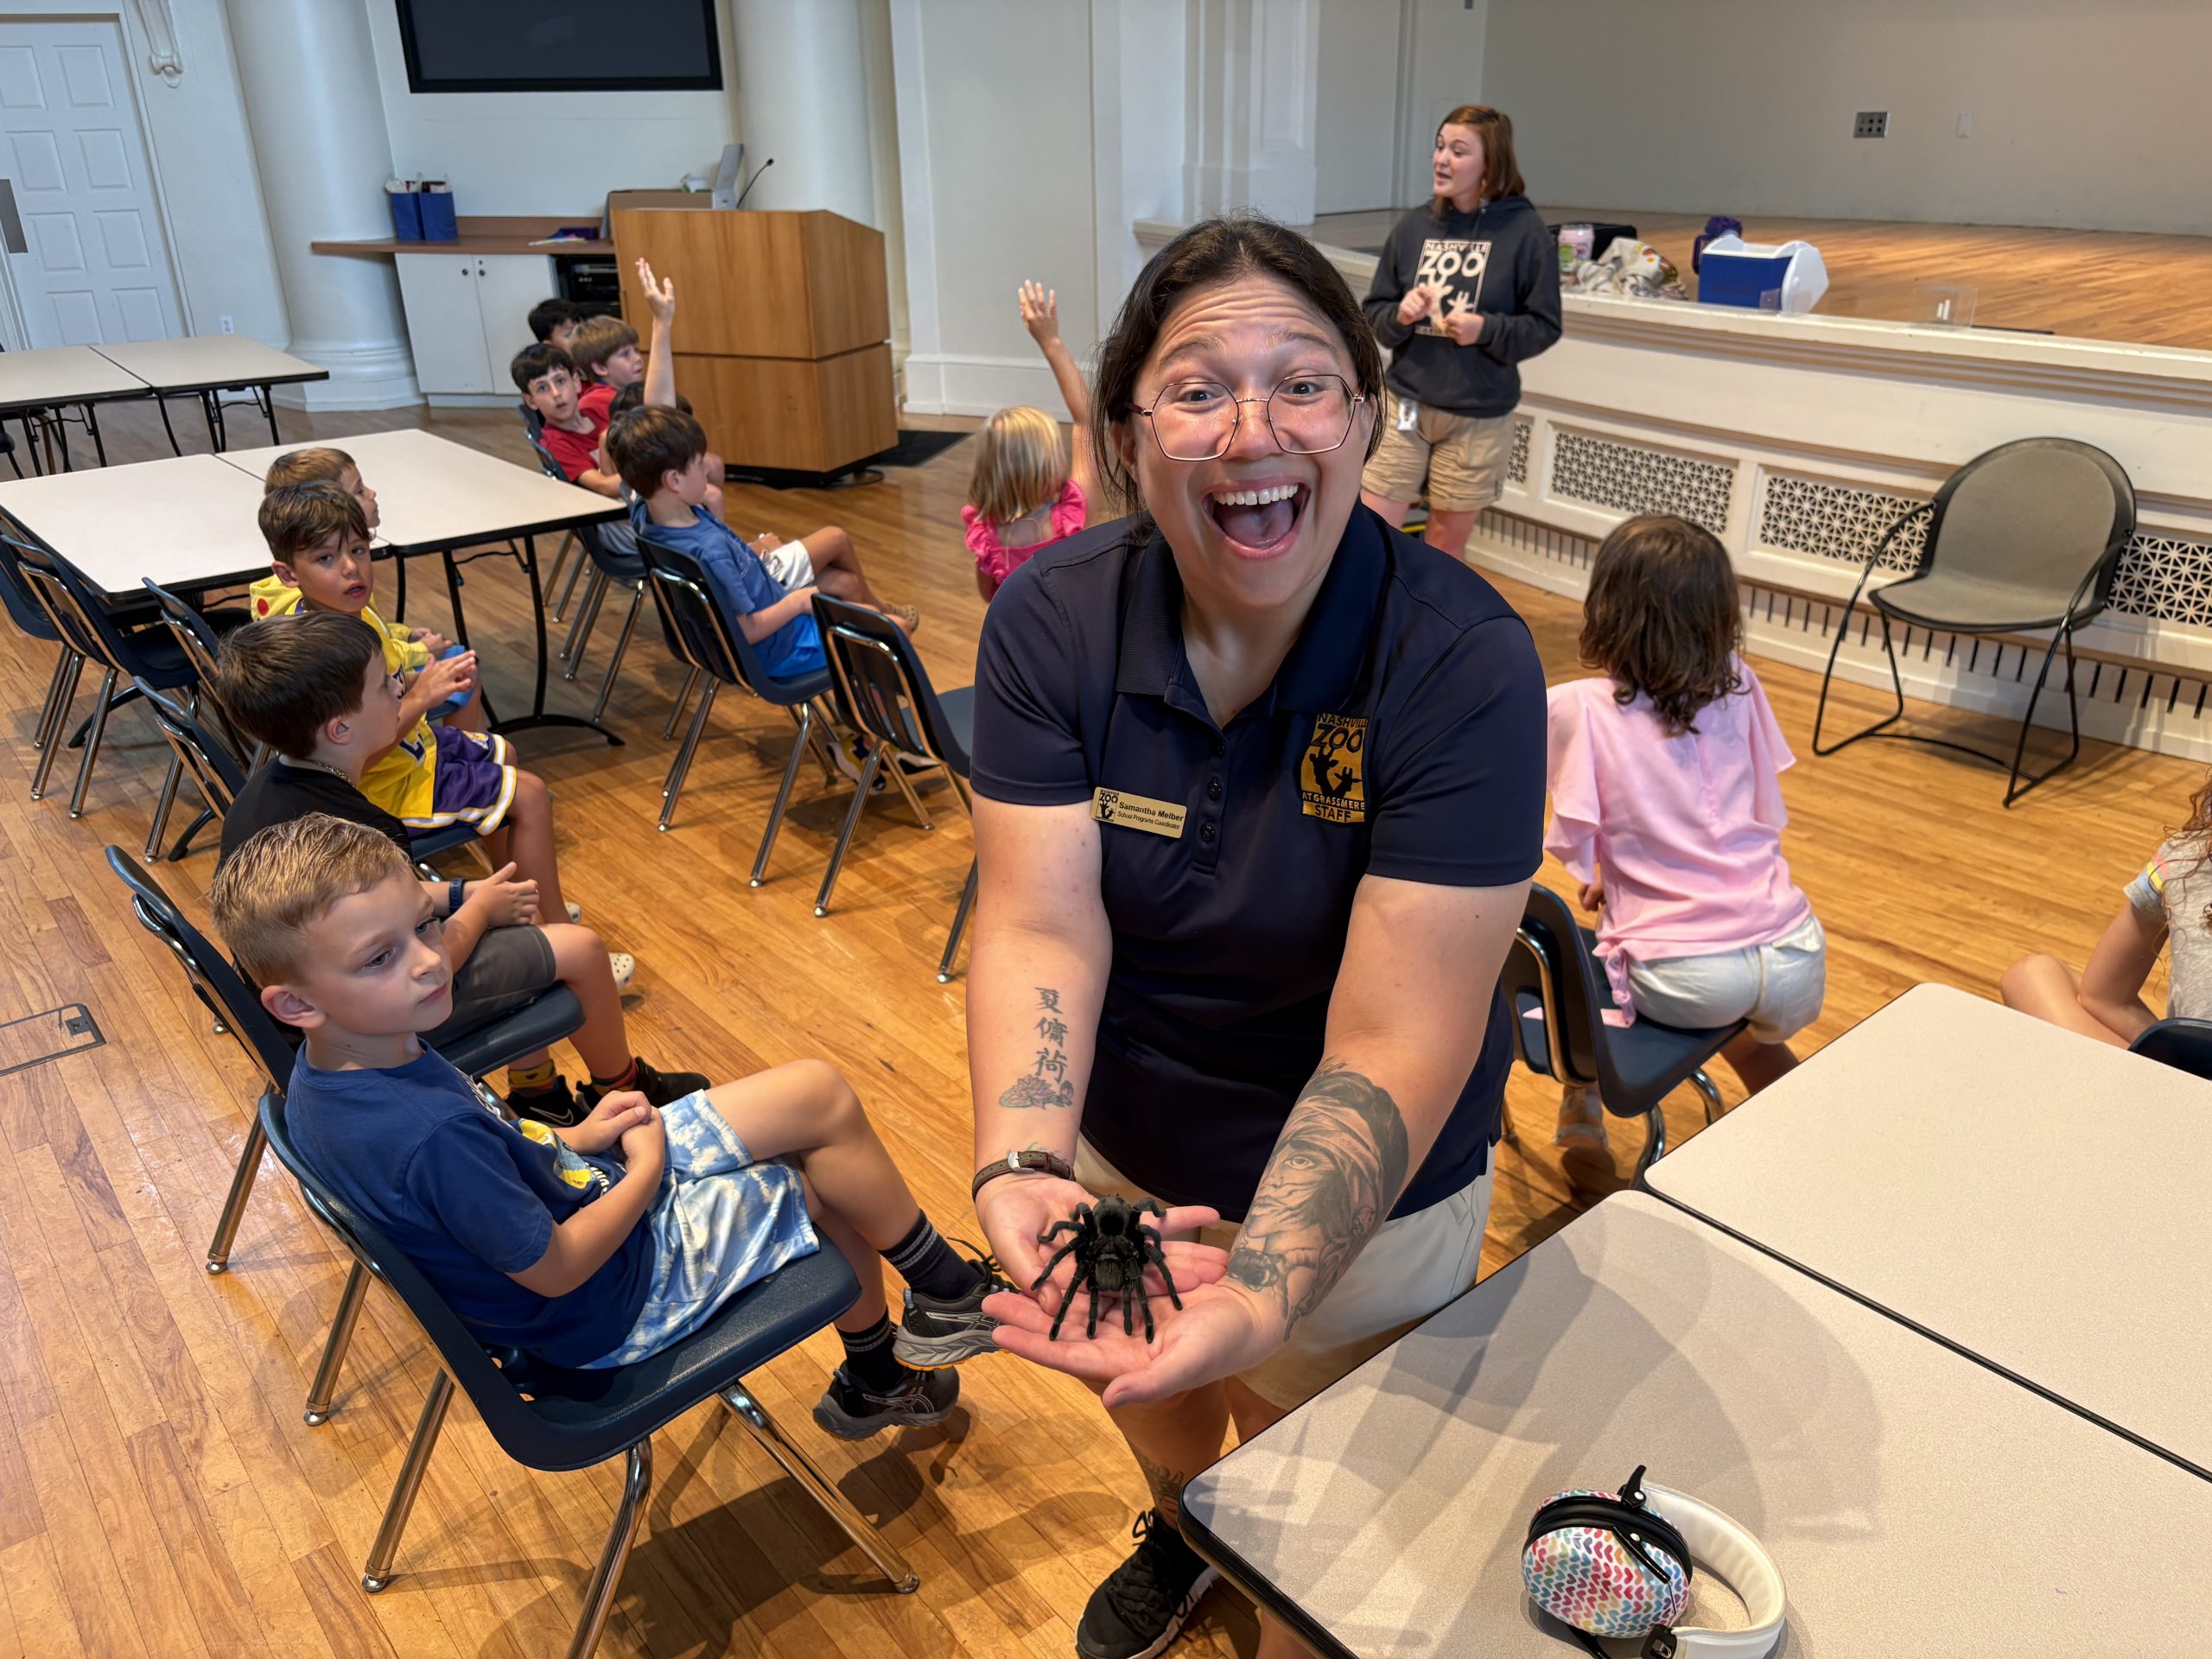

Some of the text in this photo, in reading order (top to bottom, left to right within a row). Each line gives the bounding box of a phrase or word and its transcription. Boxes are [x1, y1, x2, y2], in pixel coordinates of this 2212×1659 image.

[1418, 250, 1484, 277] ZOO
[1316, 713, 1370, 728] NASHVILLE
[1310, 722, 1363, 753] ZOO
[1098, 792, 1119, 804] ZOO
[1302, 791, 1365, 810] AT GRASSMERE
[1119, 802, 1156, 816] Samantha
[1314, 804, 1352, 823] STAFF
[1133, 814, 1154, 824] Programs
[1154, 819, 1180, 830] Coordinator
